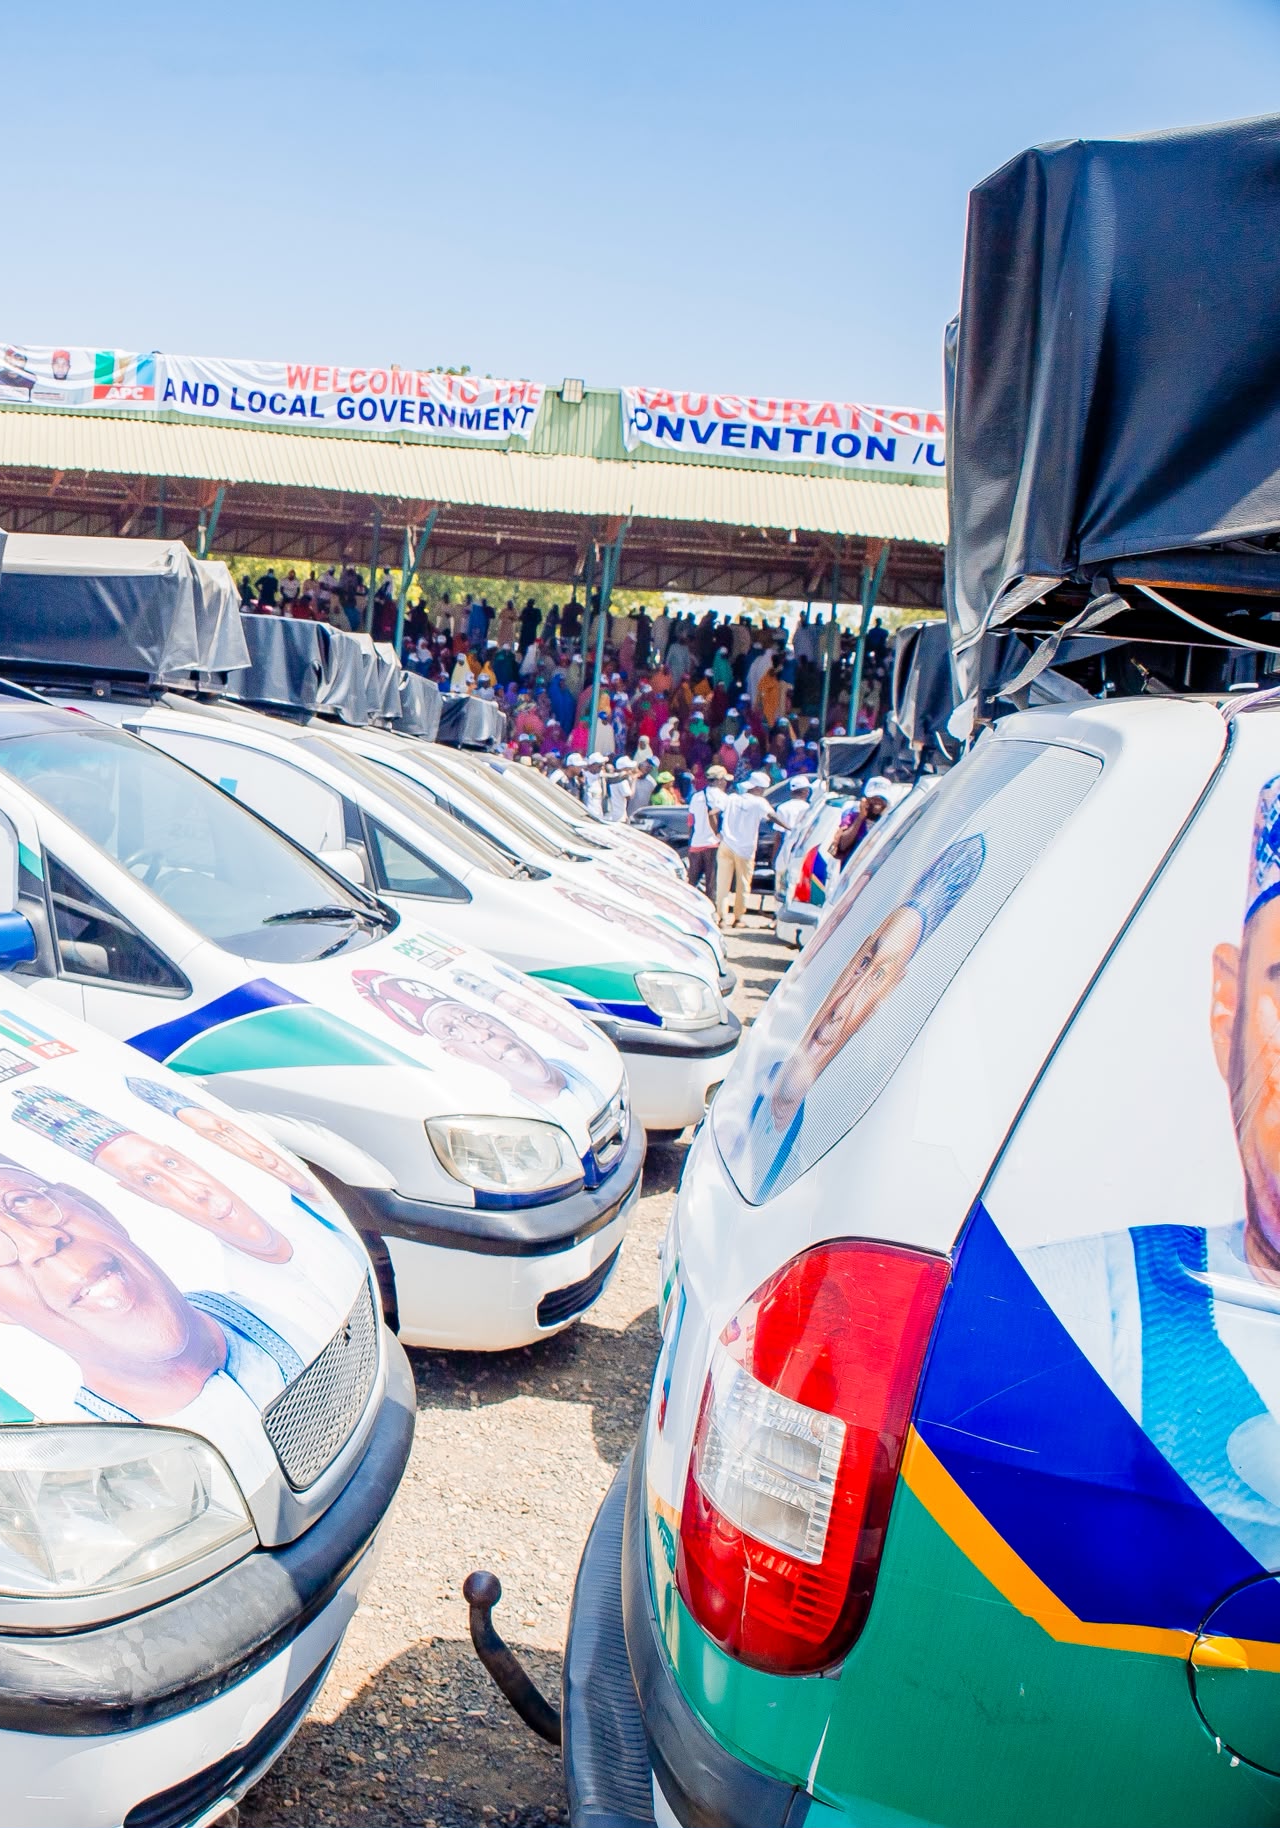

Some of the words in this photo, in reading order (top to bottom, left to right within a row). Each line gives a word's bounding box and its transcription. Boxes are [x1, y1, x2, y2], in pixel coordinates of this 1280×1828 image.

[105, 387, 145, 400] APC
[163, 378, 220, 407] AND
[230, 387, 325, 419] LOCAL
[337, 396, 534, 431] GOVERNMENT
[286, 364, 430, 398] WELCOME
[444, 373, 480, 404] TO
[494, 380, 542, 405] THE
[630, 407, 897, 462] ONVENTION
